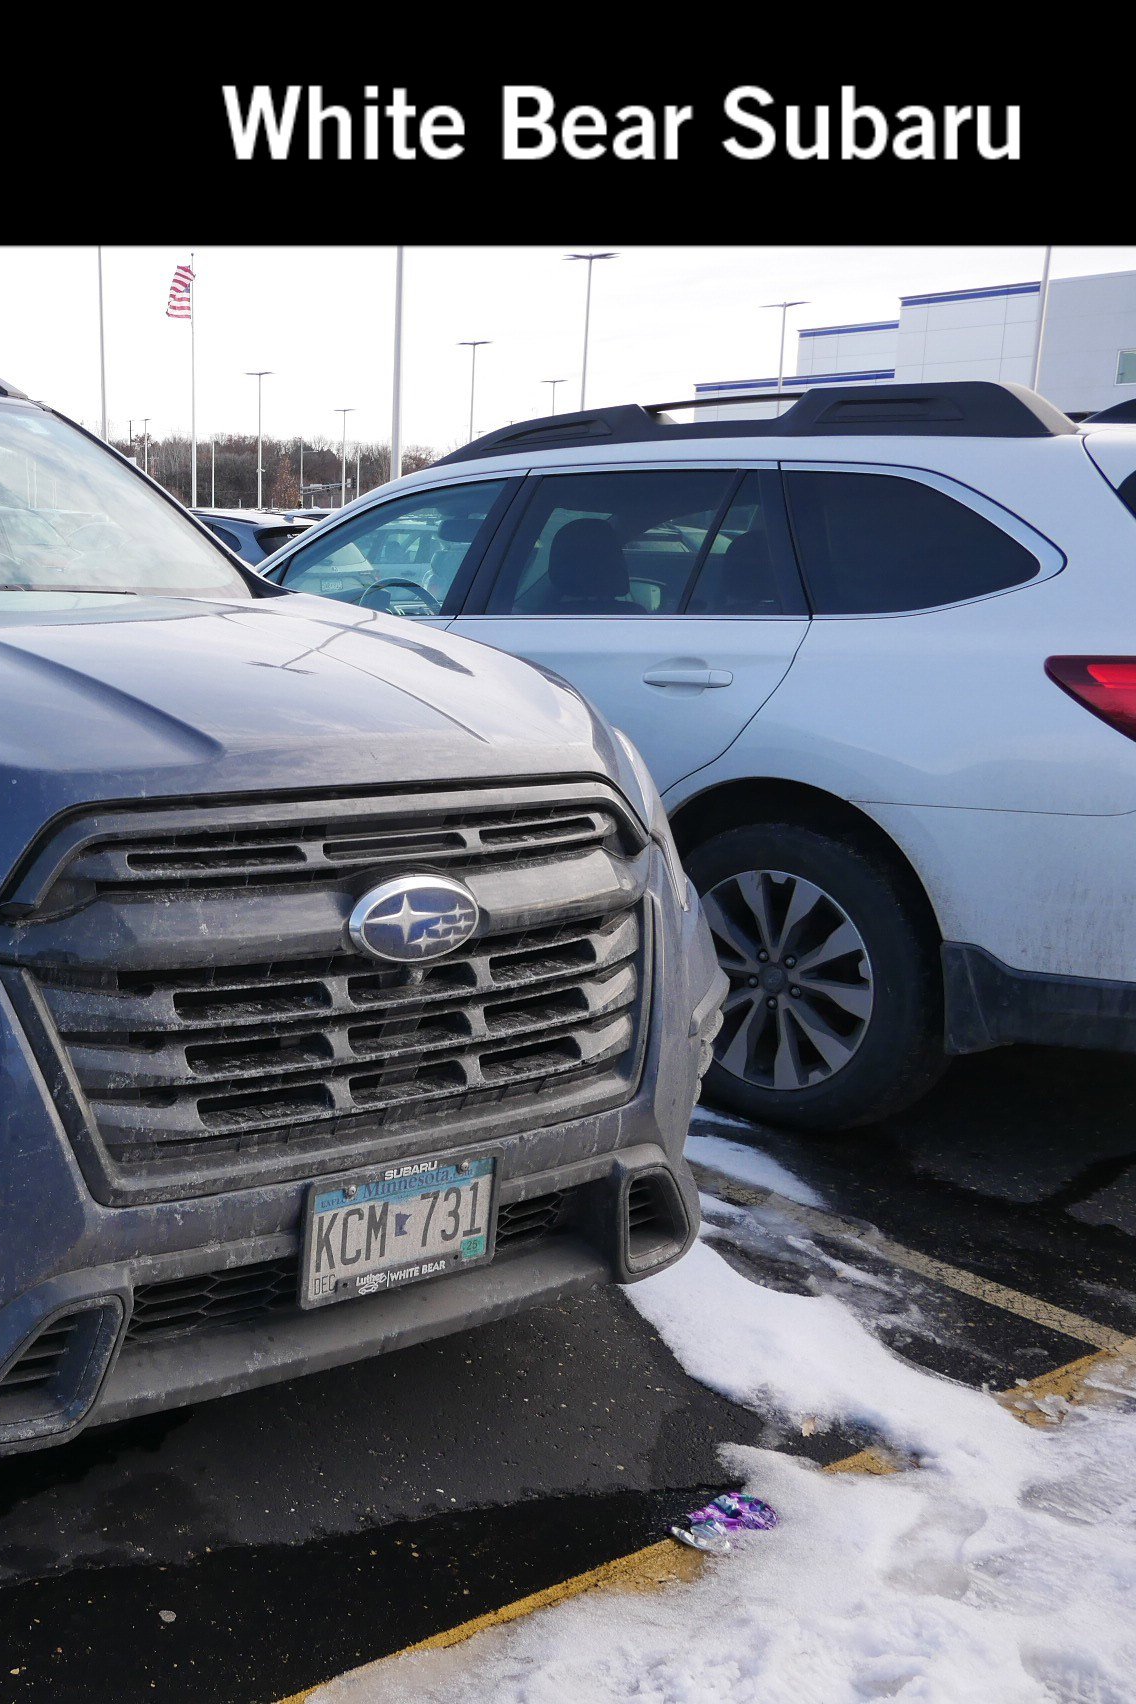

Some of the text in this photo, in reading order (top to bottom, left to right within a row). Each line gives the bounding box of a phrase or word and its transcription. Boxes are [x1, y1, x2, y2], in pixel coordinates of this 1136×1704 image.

[384, 1161, 438, 1181] SUBARU
[315, 1181, 482, 1273] KCM 731
[466, 1240, 478, 1250] 25
[390, 1266, 420, 1282] WHITE
[421, 1260, 446, 1275] BEAR
[314, 1274, 336, 1295] DEC
